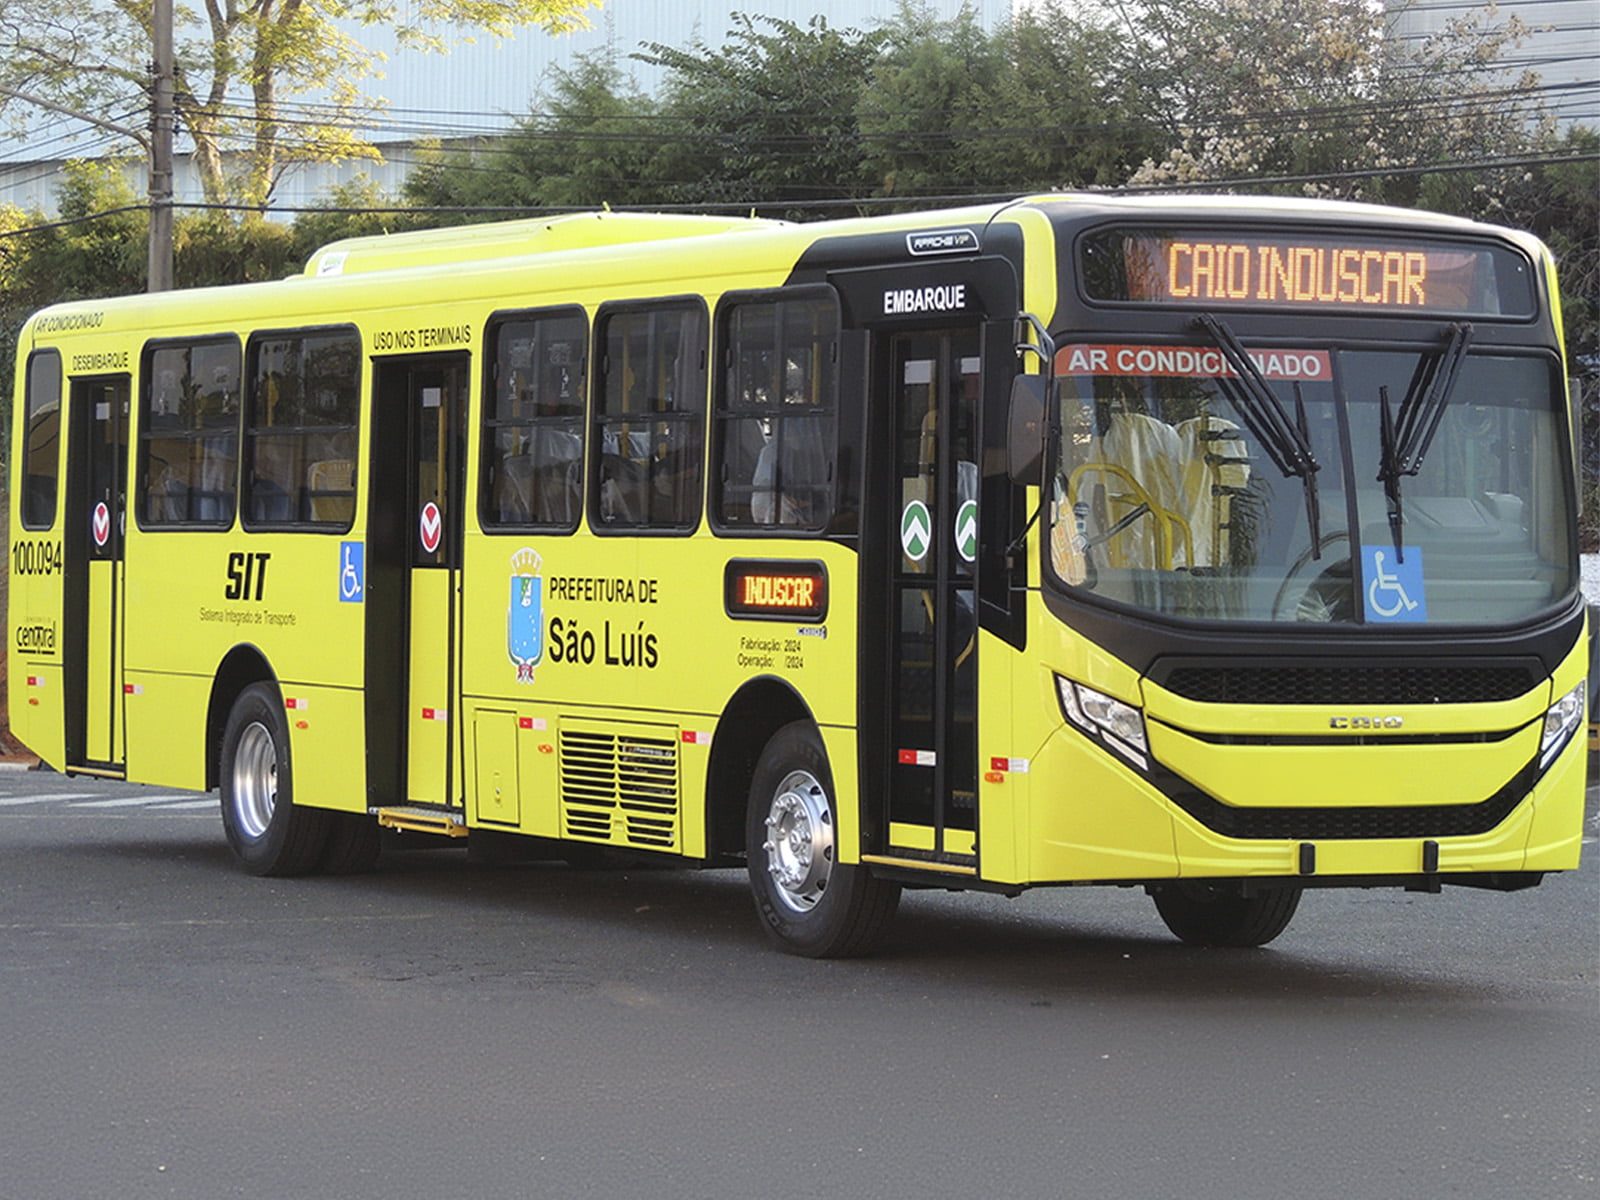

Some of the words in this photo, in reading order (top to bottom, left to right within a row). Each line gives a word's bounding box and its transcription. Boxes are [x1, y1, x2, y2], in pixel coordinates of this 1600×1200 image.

[1168, 242, 1250, 299] CAIO
[1256, 246, 1427, 306] INDUSCAR
[883, 284, 966, 314] EMBARQUE
[373, 331, 393, 350] USO
[395, 330, 416, 349] NOS
[418, 324, 472, 348] TERMINAIS
[72, 352, 129, 371] DESEMBARQUE
[1068, 350, 1109, 371] AR
[1116, 350, 1321, 377] CONDICINADO
[12, 541, 62, 575] 100.094
[225, 552, 271, 601] SIT
[549, 576, 635, 603] PREFEITURA
[638, 579, 658, 604] DE
[744, 575, 814, 607] INDUSCAR
[200, 607, 223, 622] Sistema
[224, 609, 253, 627] Integrado
[263, 610, 297, 628] Transporte
[549, 616, 596, 664] São
[604, 620, 659, 669] Luís
[784, 639, 801, 653] 2024
